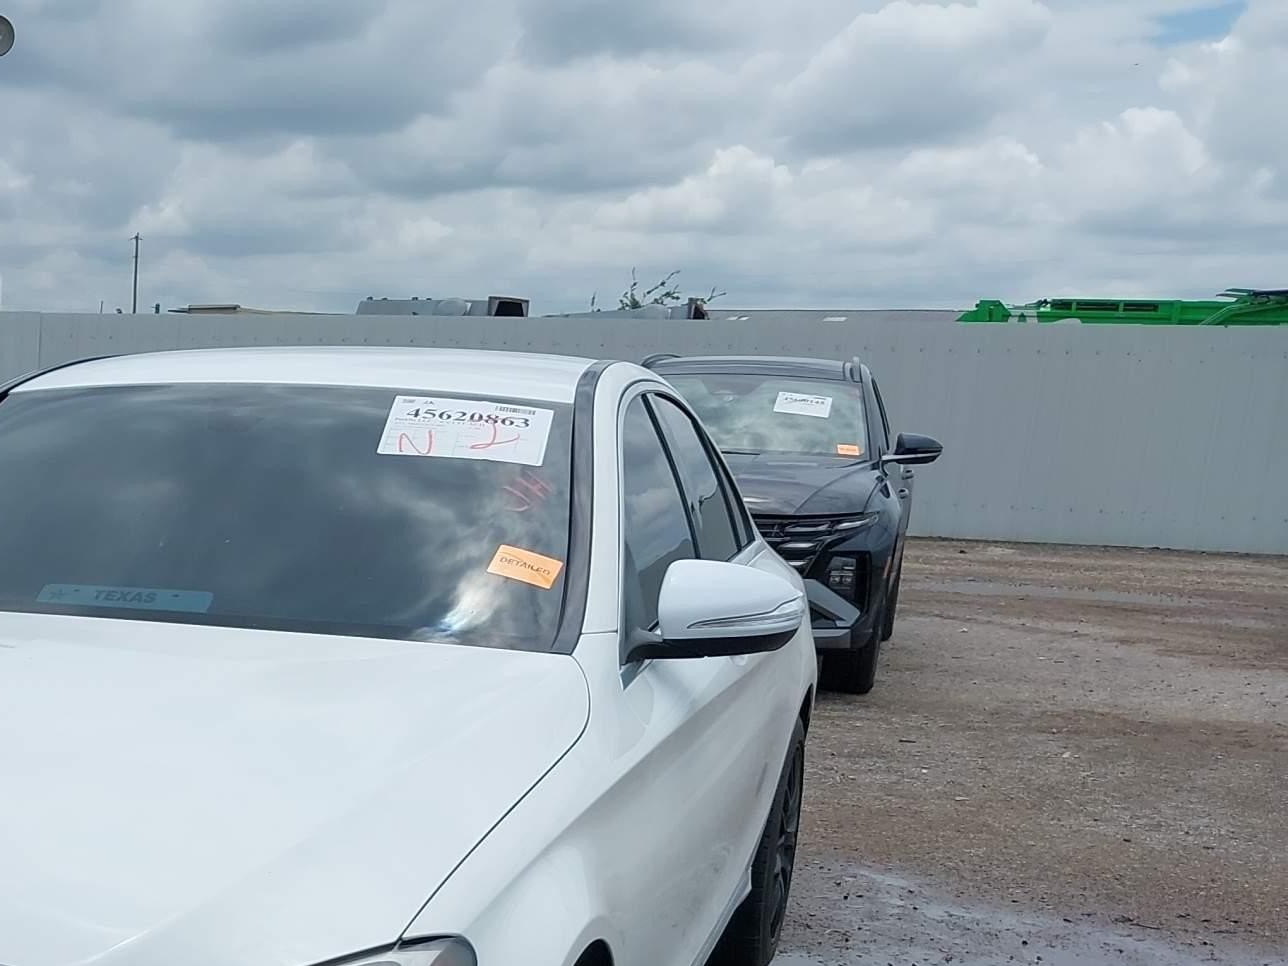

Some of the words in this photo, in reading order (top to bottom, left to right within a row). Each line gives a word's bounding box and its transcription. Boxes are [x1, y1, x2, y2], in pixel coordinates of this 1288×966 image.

[406, 407, 530, 428] 45620863
[499, 556, 551, 576] DETAILED
[94, 589, 159, 604] TEXAS
